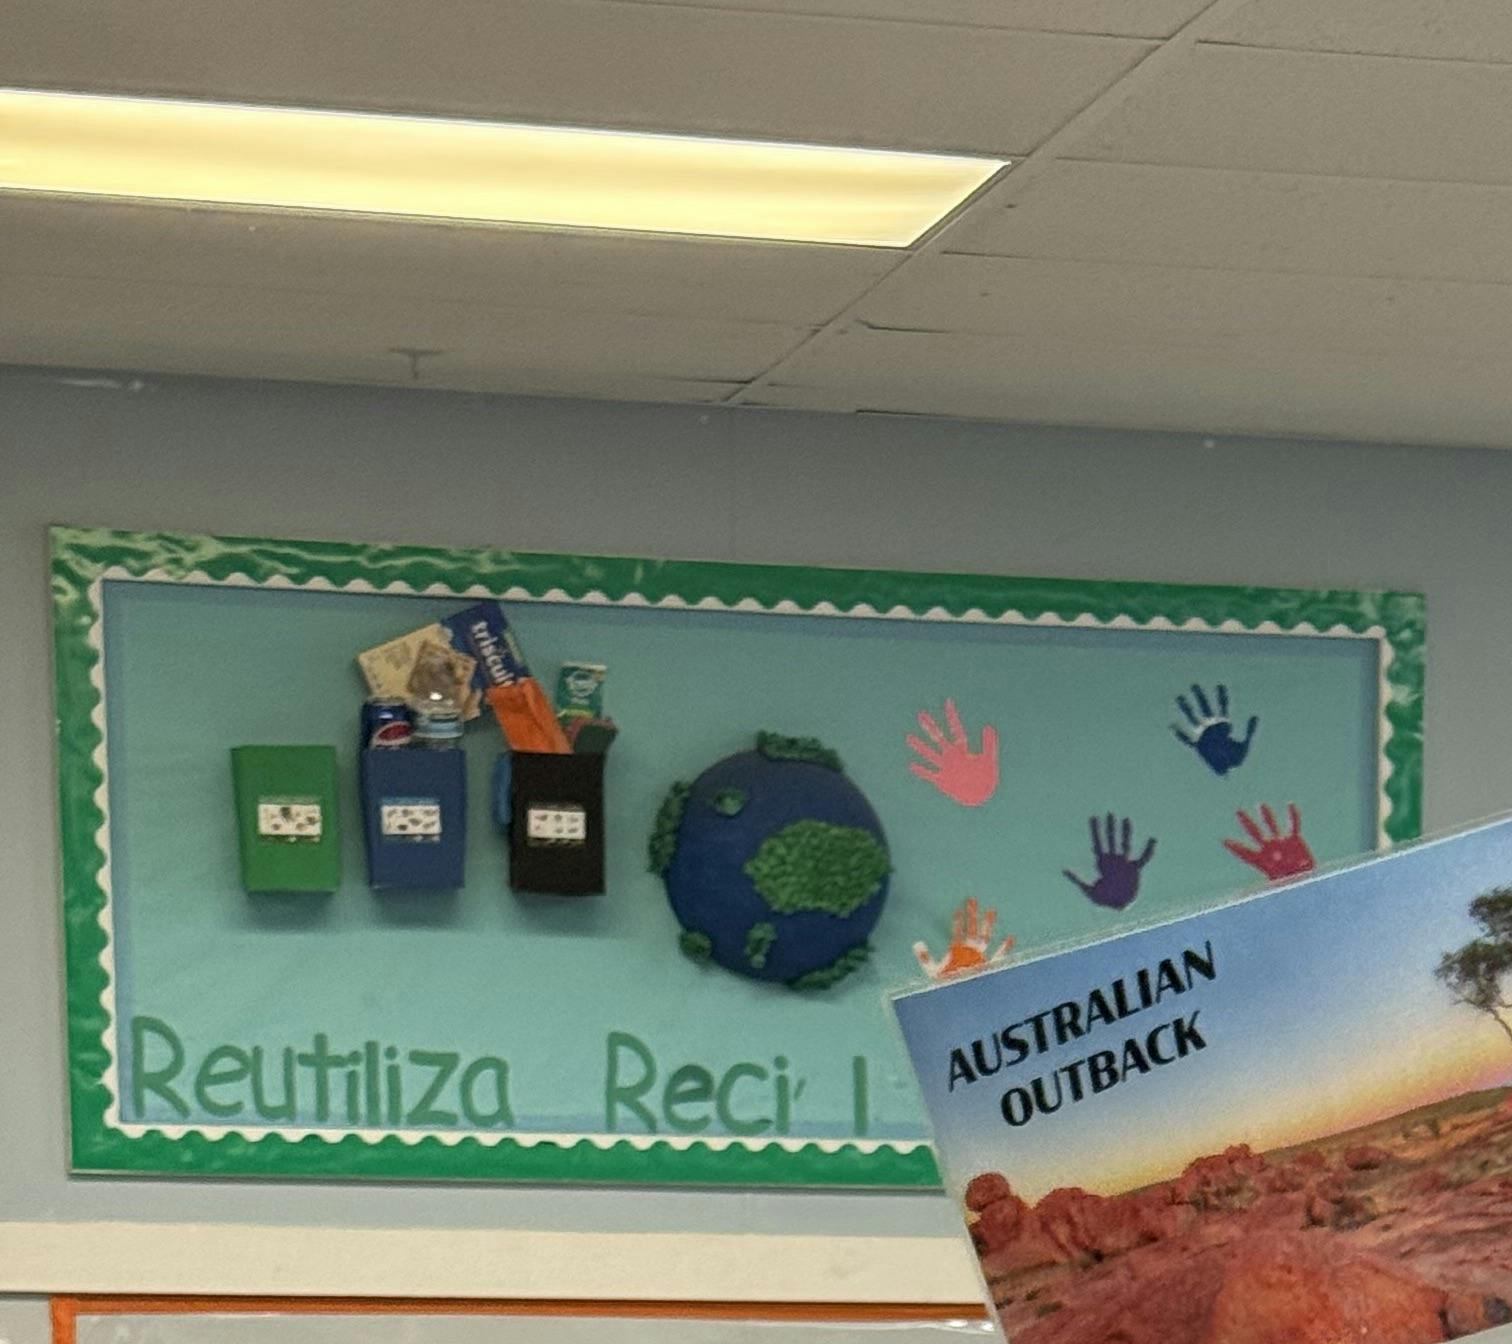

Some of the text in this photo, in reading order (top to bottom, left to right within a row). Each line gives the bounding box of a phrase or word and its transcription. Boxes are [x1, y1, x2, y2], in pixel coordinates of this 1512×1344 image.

[130, 1017, 514, 1128] Reutiliza
[944, 939, 1219, 1093] AUSTRALIAN
[998, 1008, 1209, 1128] OUTBACK
